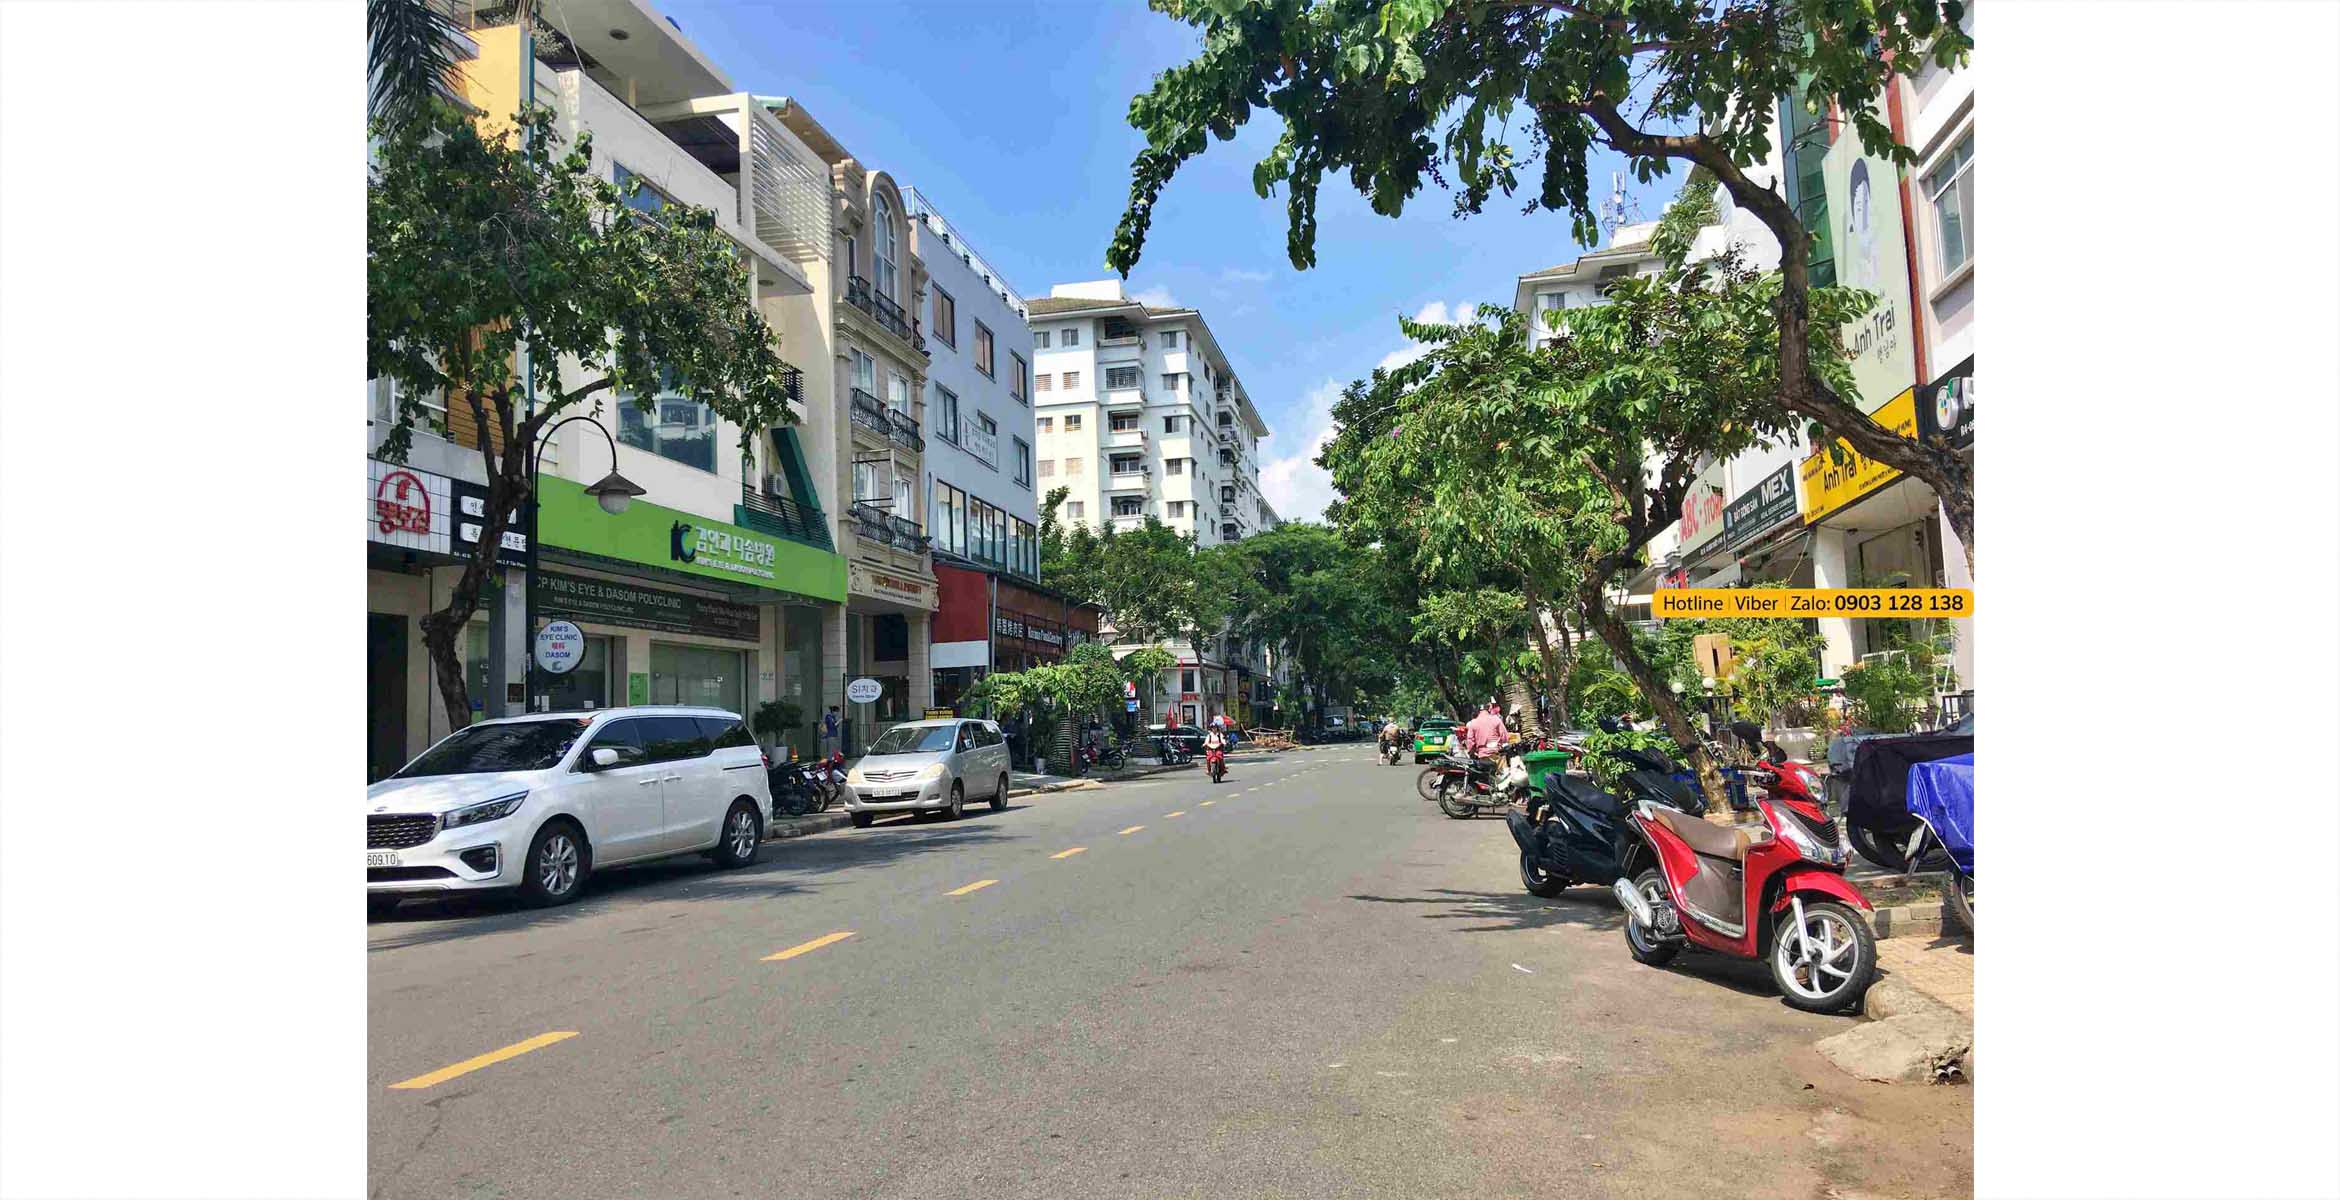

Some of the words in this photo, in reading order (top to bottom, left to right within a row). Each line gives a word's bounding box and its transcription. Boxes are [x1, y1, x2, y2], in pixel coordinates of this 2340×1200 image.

[1855, 324, 1872, 356] Anh
[1873, 299, 1895, 340] Trai
[1761, 469, 1790, 506] MEX
[1824, 466, 1840, 493] Anh
[1680, 491, 1699, 543] ABC
[695, 525, 731, 556] 김안과
[733, 536, 775, 567] 다솜병원
[550, 578, 576, 593] KIM'S
[580, 583, 595, 597] EYE
[598, 588, 604, 598] &
[606, 588, 636, 601] DASOM
[639, 593, 681, 608] POLYCLINIC
[367, 854, 396, 866] 609.10
